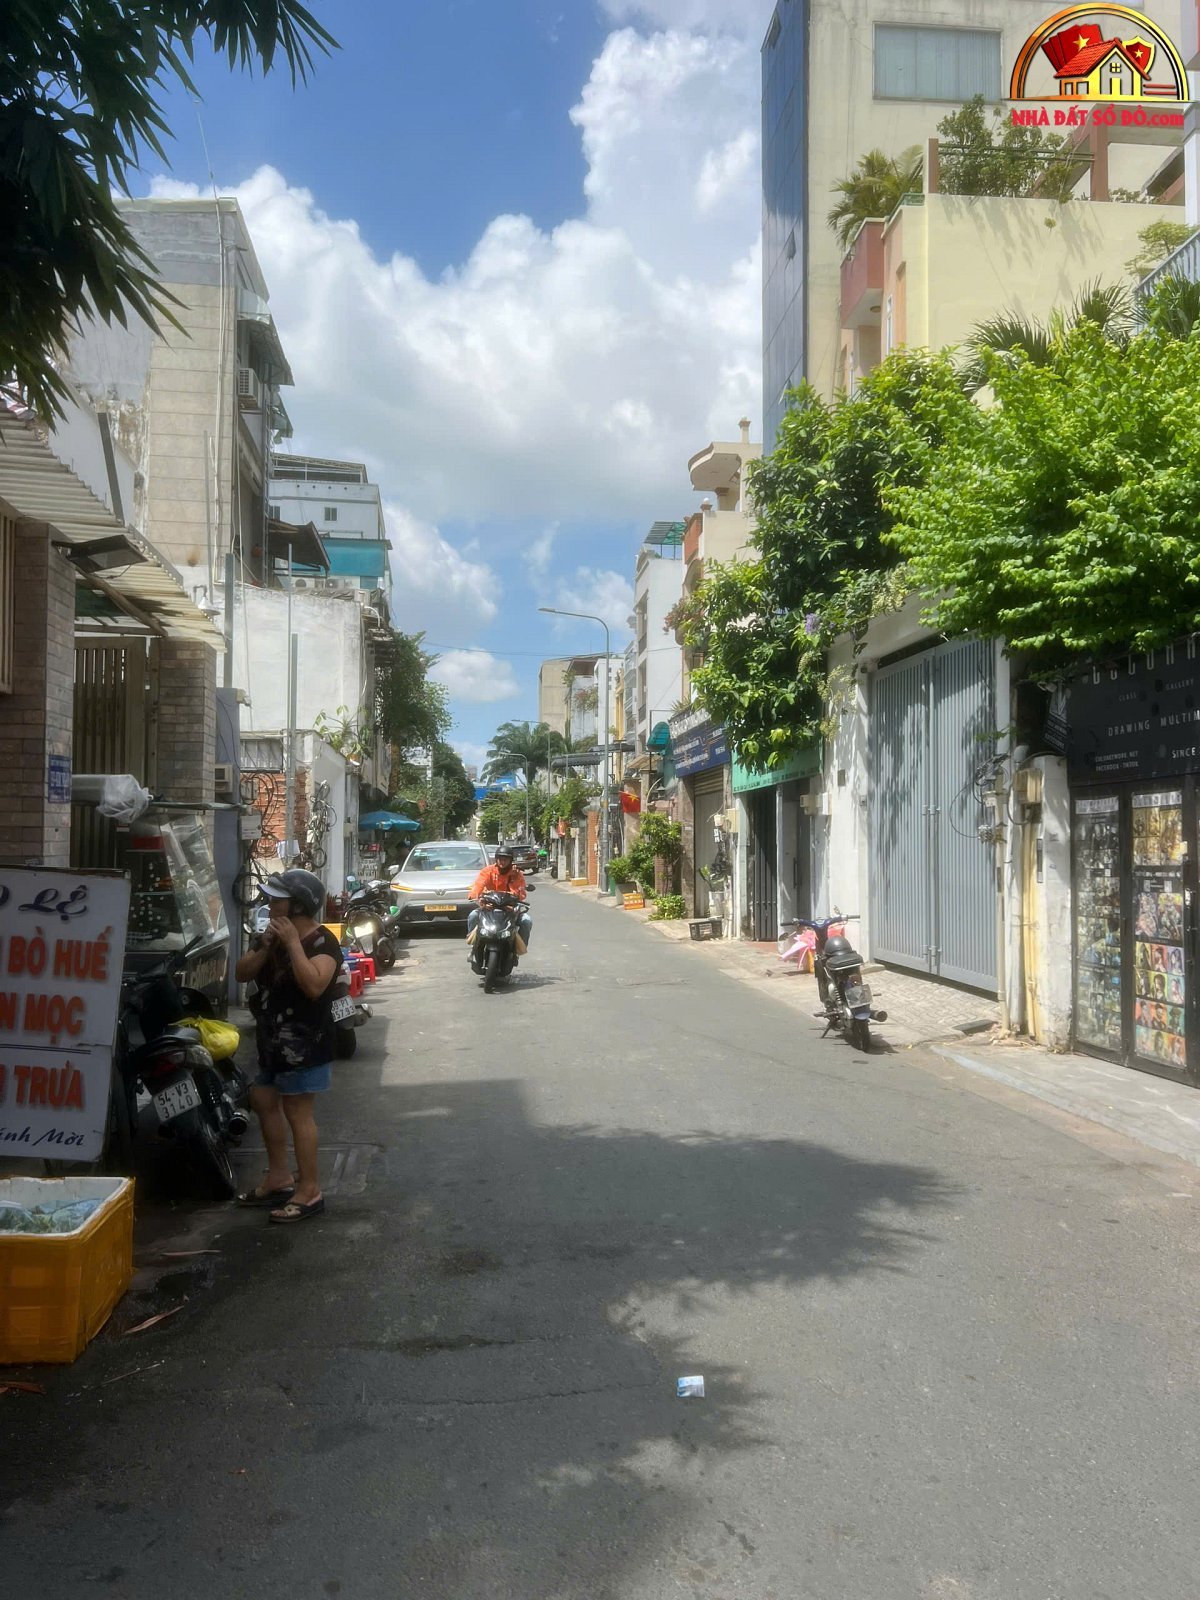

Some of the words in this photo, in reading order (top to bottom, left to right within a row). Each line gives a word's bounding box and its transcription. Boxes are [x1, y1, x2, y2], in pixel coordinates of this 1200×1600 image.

[1165, 678, 1195, 691] GALLERY
[1107, 719, 1150, 737] DRAWING
[1171, 746, 1197, 759] SINCE
[18, 884, 88, 921] LỆ
[8, 926, 47, 977] BÒ
[52, 925, 113, 981] HUẾ
[24, 993, 85, 1044] MỌC
[14, 1059, 85, 1109] TRƯA
[158, 1083, 189, 1105] 54-V3
[162, 1095, 193, 1119] 3140
[32, 1127, 85, 1146] Mời
